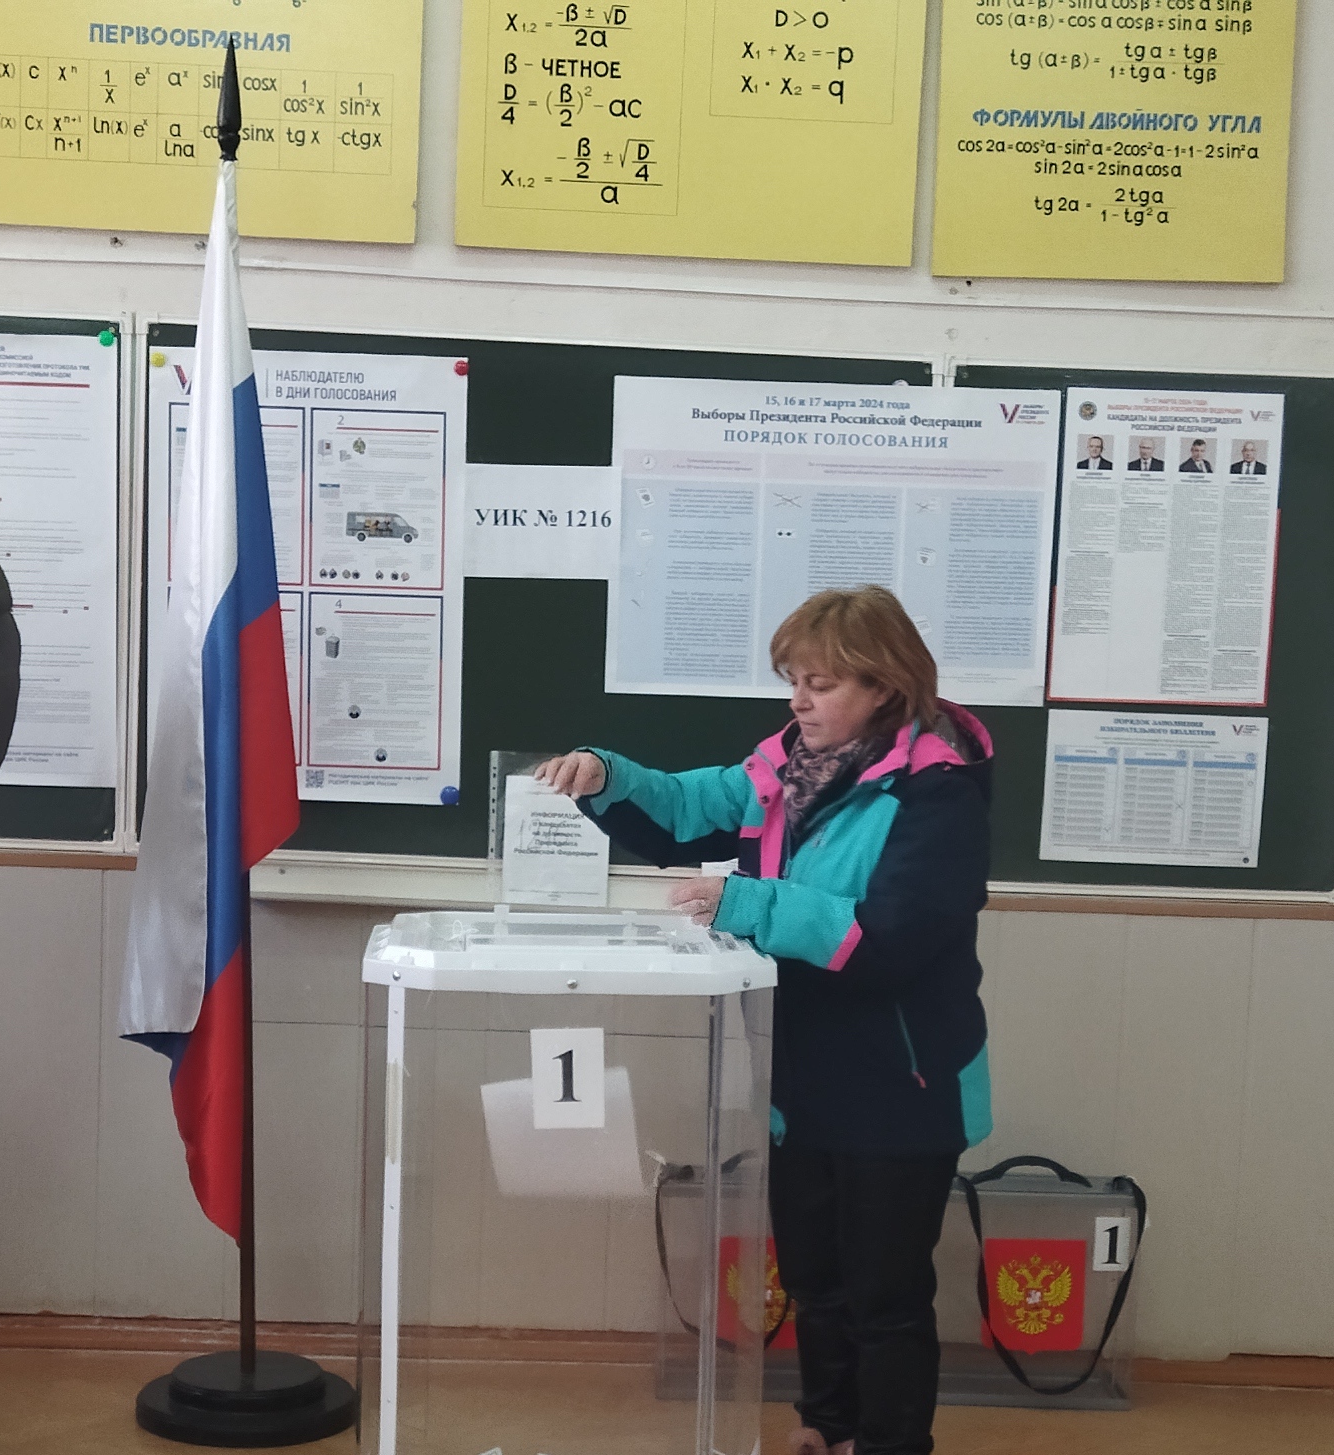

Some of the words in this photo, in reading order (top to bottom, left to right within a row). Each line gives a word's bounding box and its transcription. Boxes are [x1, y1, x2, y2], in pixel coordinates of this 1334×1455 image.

[89, 23, 291, 53] ПЕРВООБРАЗНАЯ
[541, 59, 621, 79] ЧЕТНОЕ
[972, 108, 1085, 129] ФОРМУЛЫ
[1089, 109, 1198, 131] ДВОЙНОГО
[1208, 115, 1262, 134] УГЛА
[276, 369, 364, 384] НАБЛЮДАТЕЛЮ
[276, 387, 283, 397] В
[286, 388, 311, 400] ДНИ
[314, 389, 396, 401] ГОЛОСОВАНИЯ
[766, 396, 780, 407] 15,
[784, 396, 796, 406] 16
[809, 397, 821, 407] 17
[824, 400, 856, 410] марта
[860, 399, 884, 408] 2024
[887, 401, 910, 411] года
[338, 414, 344, 425] 2
[692, 408, 746, 422] Выборы
[749, 410, 827, 425] Президента
[831, 413, 906, 427] Российской
[910, 415, 982, 429] Федерации
[724, 430, 807, 445] ПОРЯДОК
[814, 432, 949, 449] ГОЛОСОВАНИЯ
[475, 509, 527, 526] УИК
[534, 509, 558, 527] №
[566, 510, 611, 527] 1216
[335, 599, 342, 609] 4
[552, 1049, 581, 1102] 1
[1102, 1226, 1121, 1264] 1
